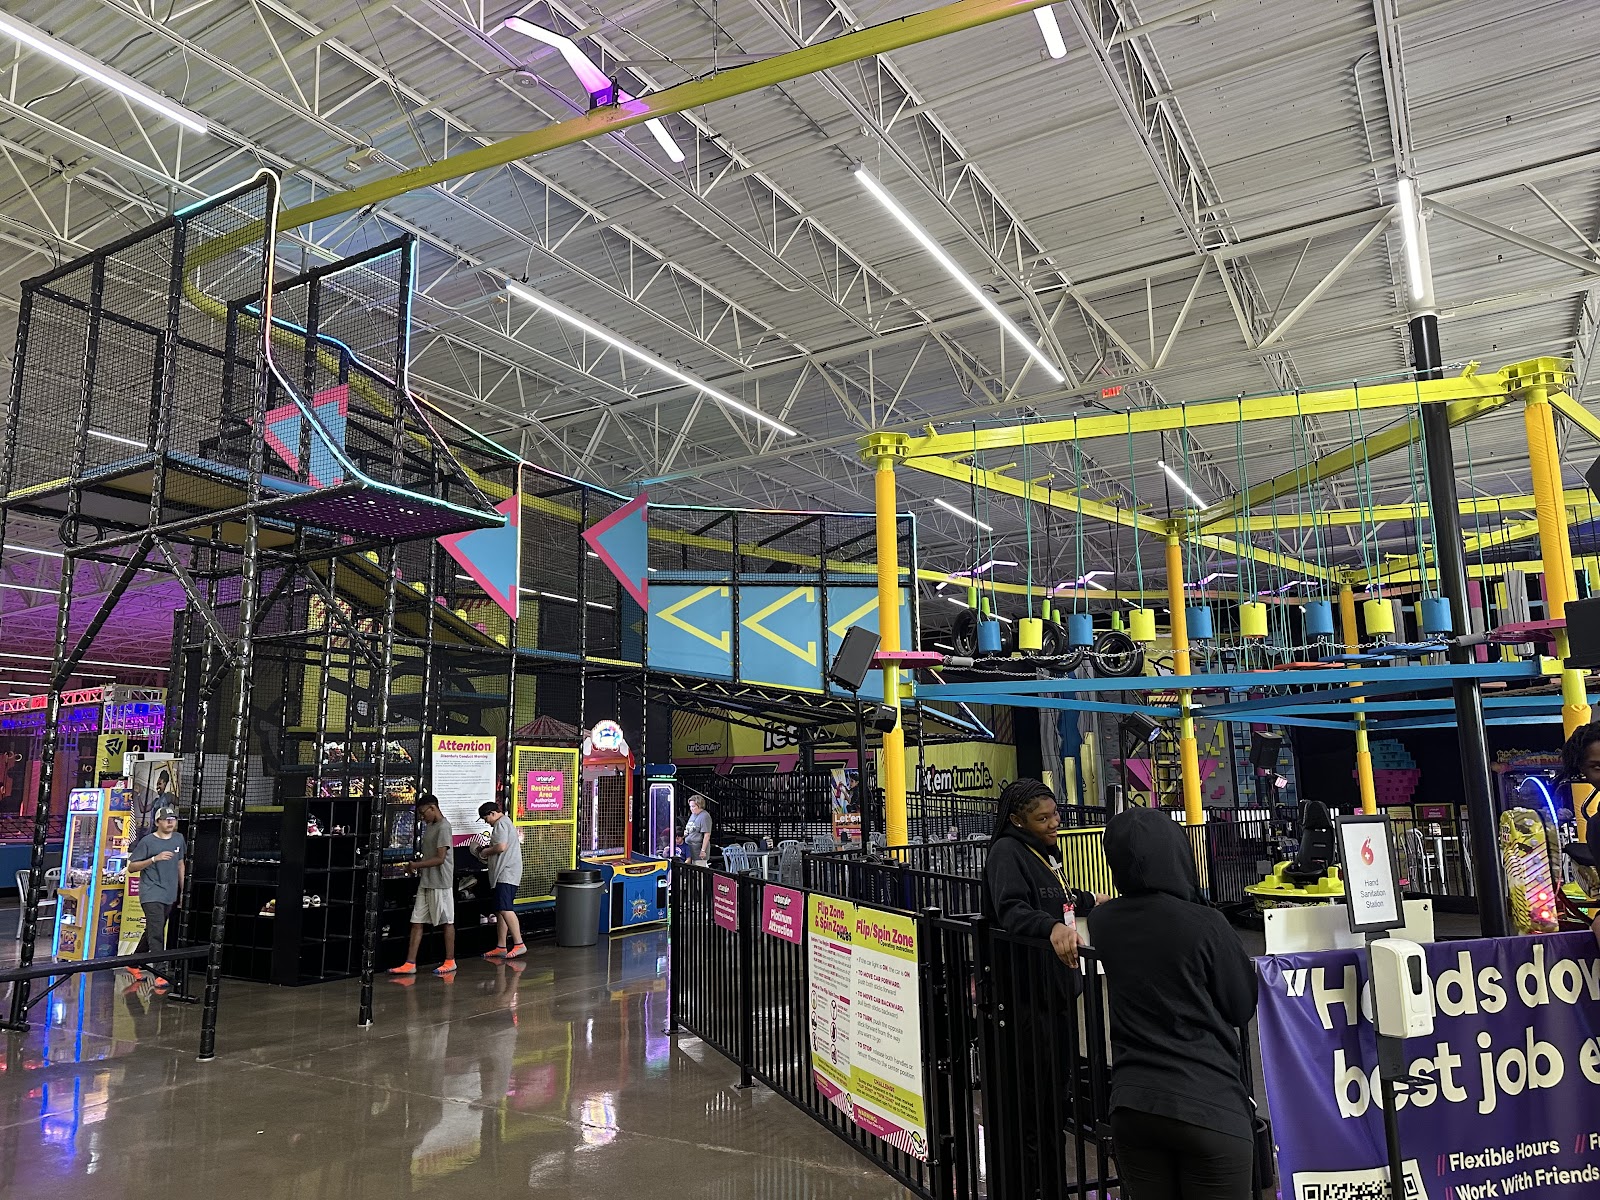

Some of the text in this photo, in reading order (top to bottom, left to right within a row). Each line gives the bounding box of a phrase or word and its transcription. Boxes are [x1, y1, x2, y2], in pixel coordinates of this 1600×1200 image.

[438, 740, 491, 751] Attention
[1364, 879, 1379, 887] Hand
[1360, 889, 1386, 898] Sanitation
[818, 901, 844, 920] Flip Zone
[1365, 900, 1384, 908] Station
[770, 908, 792, 925] Platinum
[815, 915, 848, 933] & Spin Zone
[768, 920, 794, 938] Attraction
[856, 919, 914, 948] Flip/Spin Zone
[863, 993, 873, 1001] MOVE
[1282, 950, 1507, 1029] "Hds
[885, 1053, 893, 1061] both
[894, 1056, 908, 1068] handles
[1477, 1026, 1564, 1115] job
[1449, 1146, 1514, 1171] Flexible
[1515, 1140, 1560, 1161] Hours
[1455, 1163, 1600, 1200] Work With Friends
